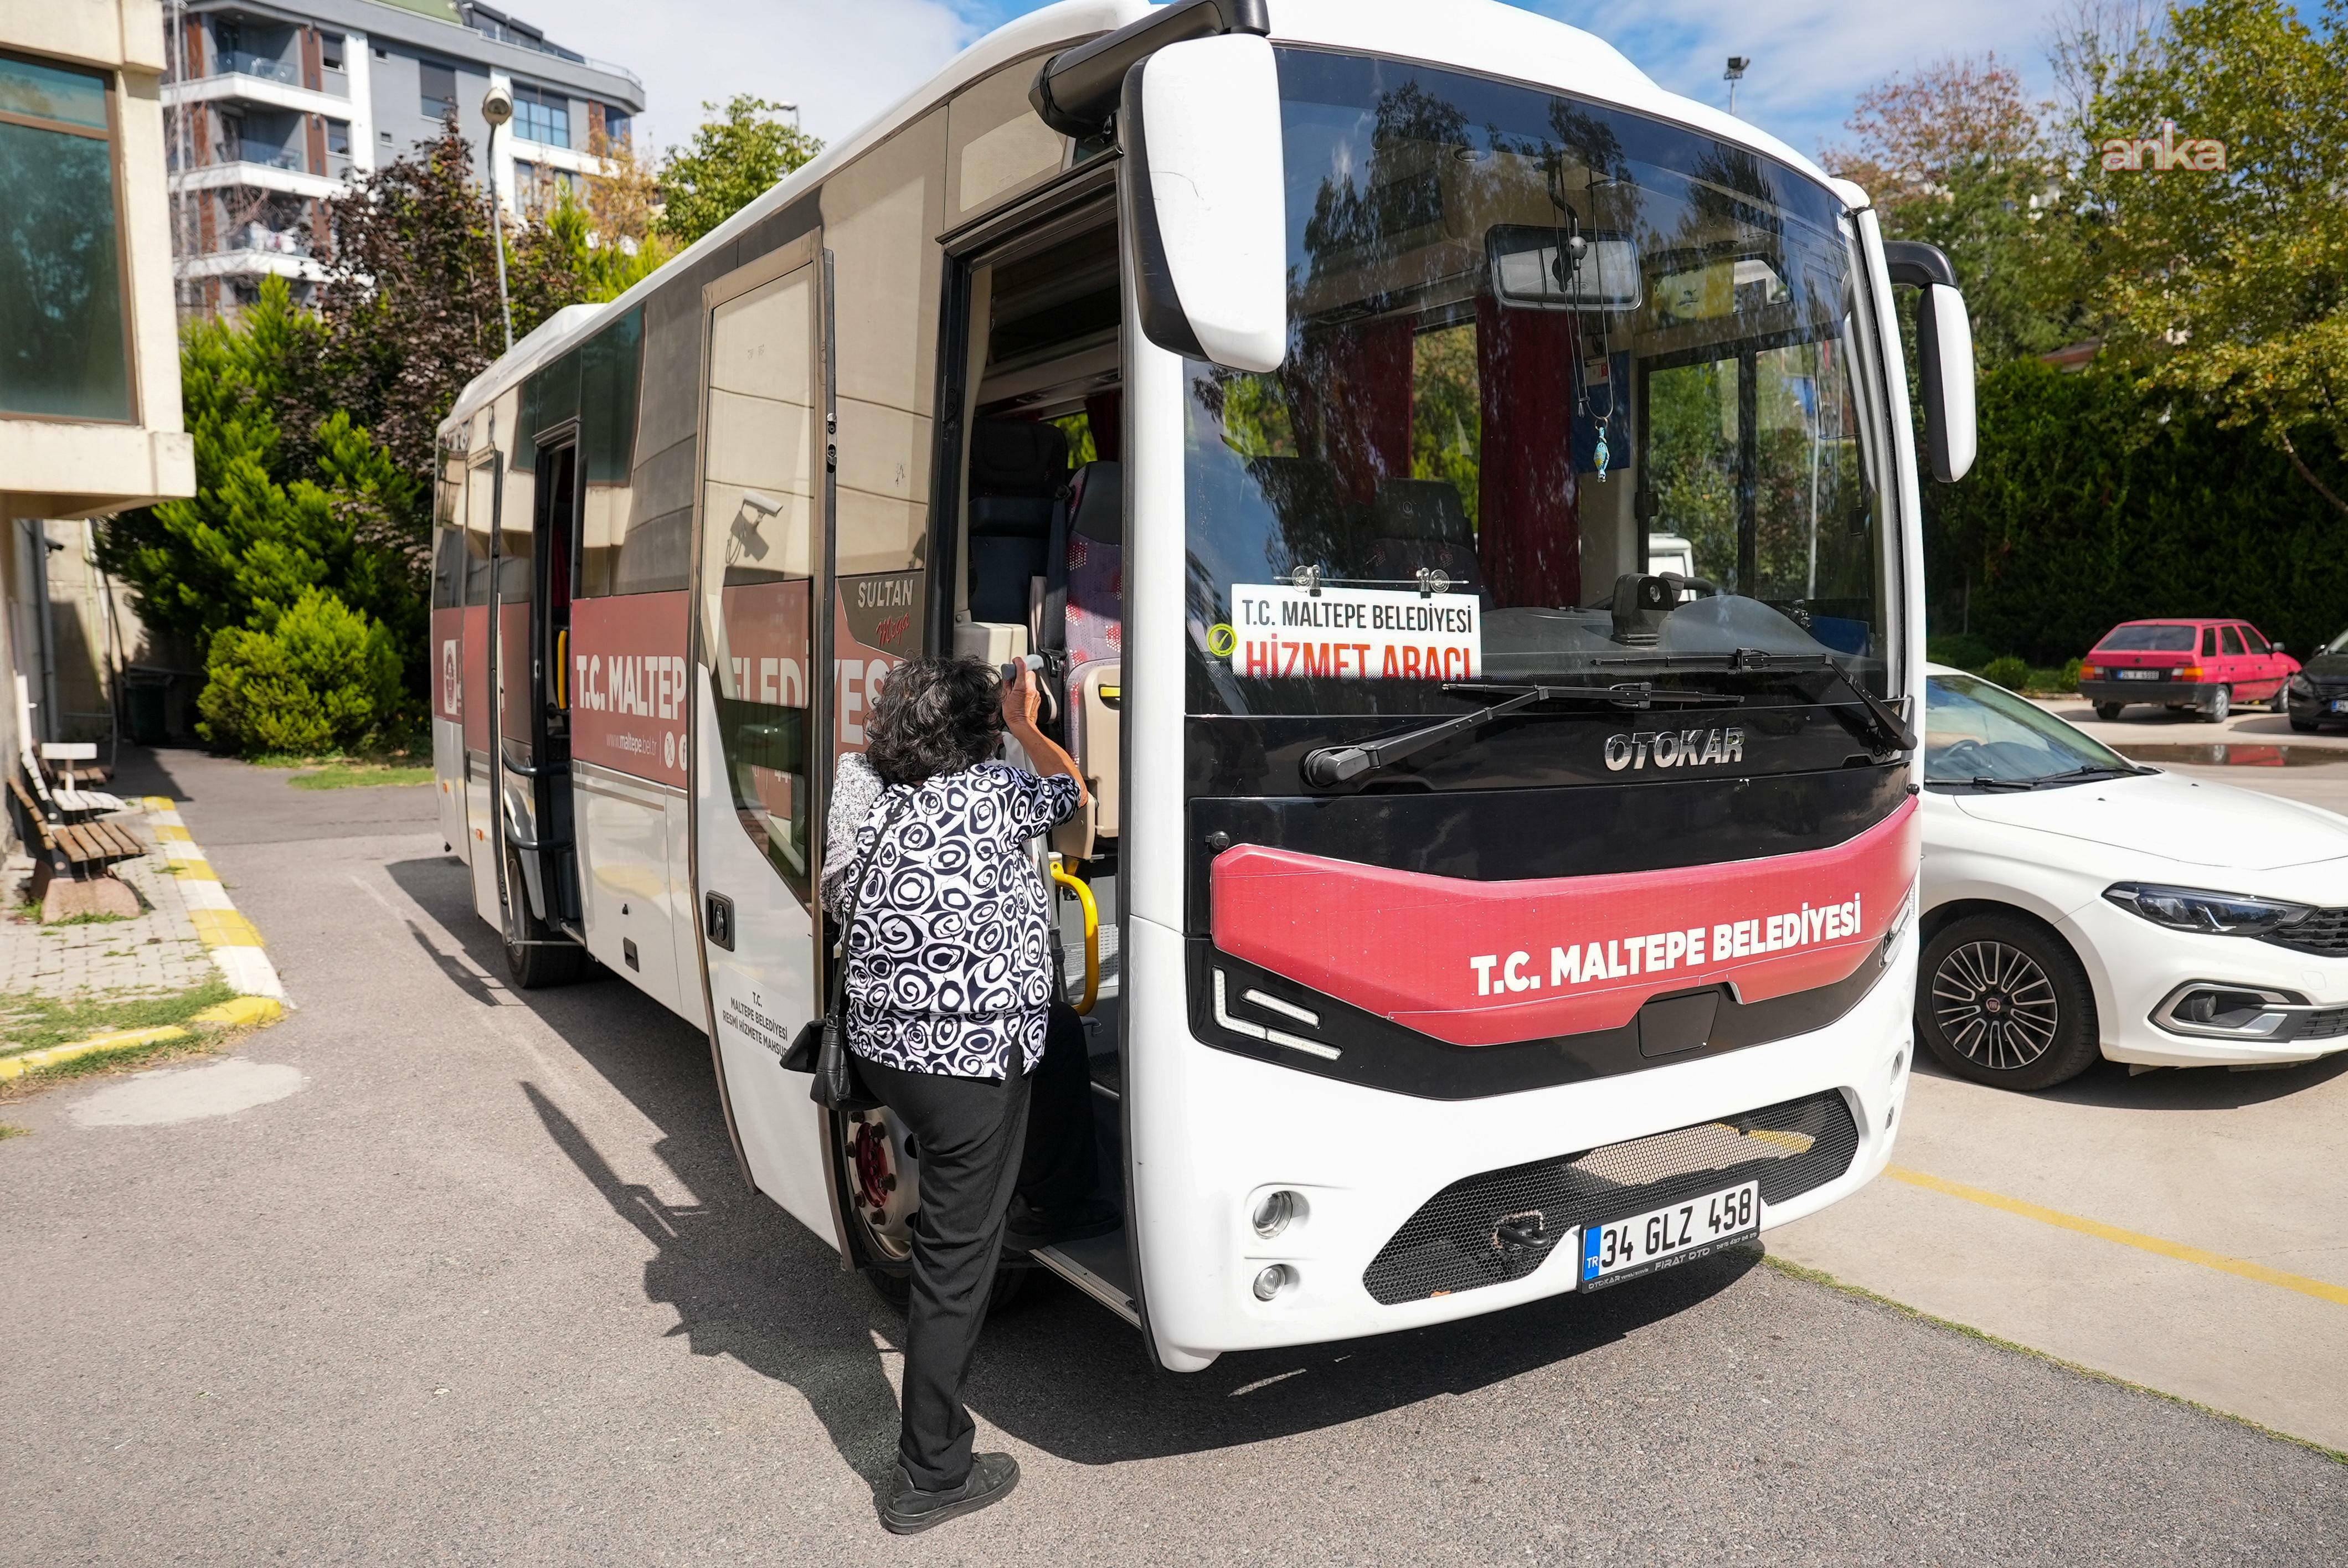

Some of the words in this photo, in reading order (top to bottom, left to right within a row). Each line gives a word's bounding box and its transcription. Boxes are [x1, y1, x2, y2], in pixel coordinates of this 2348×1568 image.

[858, 579, 914, 608] SULTAN
[1242, 600, 1275, 626] T.C.
[1283, 601, 1367, 628] MALTEPE
[1373, 603, 1471, 633] BELEDİYESİ
[1246, 633, 1371, 678] HİZMET
[1383, 645, 1471, 682] ARACI
[576, 654, 605, 711] T.C.
[609, 656, 687, 720] MALTEP
[606, 732, 657, 756] www.maltepe.bel.tr
[1605, 727, 1745, 771] OTOKAR
[1470, 950, 1541, 996] T.C.
[1551, 927, 1706, 987] MALTEPE
[1713, 892, 1861, 962] BELEDİYESİ
[752, 992, 762, 1007] T.C.
[723, 1009, 738, 1029] RESMİ
[739, 1019, 762, 1044] HİZMETE
[731, 997, 754, 1021] MALTEPE
[755, 1011, 787, 1041] BELEDİYESİ
[1602, 1225, 1634, 1268] 34
[1646, 1205, 1693, 1255] GLZ
[1708, 1188, 1751, 1234] 458
[1587, 1256, 1599, 1269] TR
[1655, 1254, 1687, 1271] FIRAT
[1688, 1247, 1711, 1260] OTO
[1588, 1275, 1620, 1290] OTOKAR
